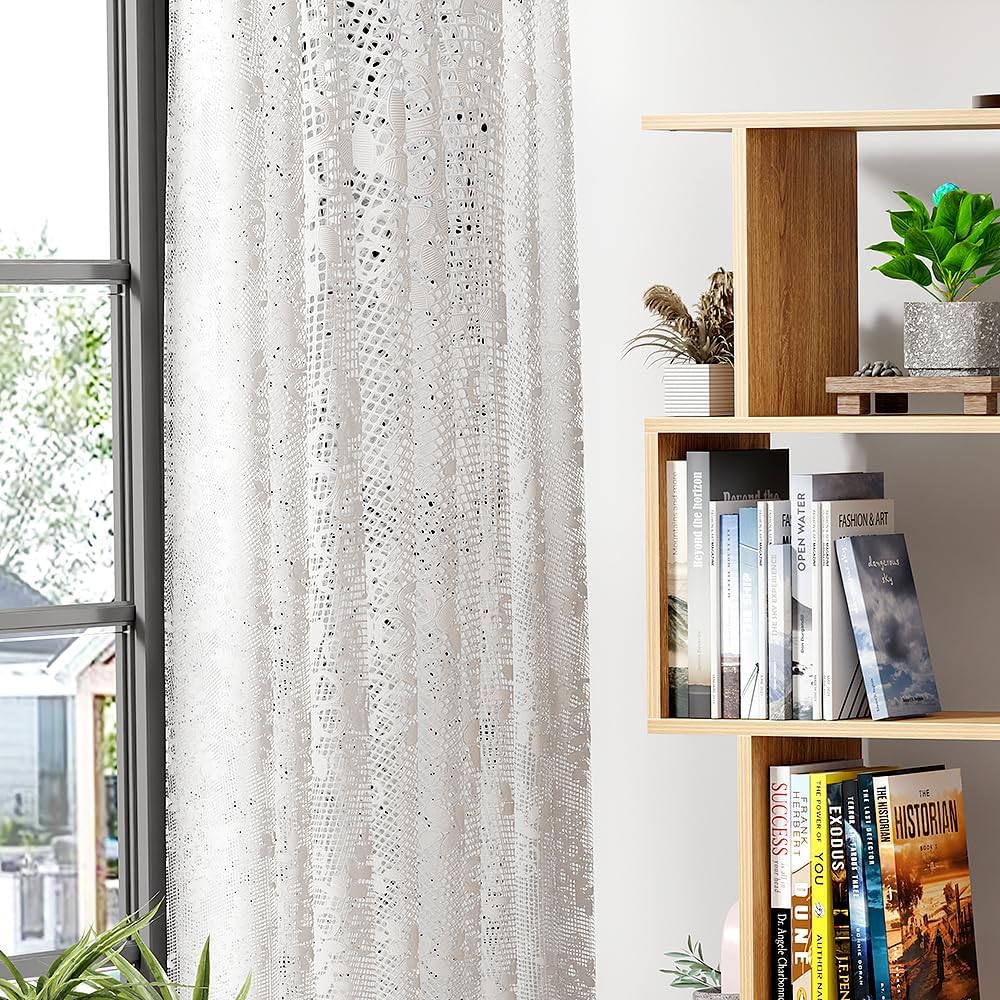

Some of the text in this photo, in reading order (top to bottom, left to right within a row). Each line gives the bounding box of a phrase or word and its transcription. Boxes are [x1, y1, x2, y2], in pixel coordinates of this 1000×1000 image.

[692, 472, 704, 568] Beyond the horizon
[797, 492, 806, 572] OPEN WATER
[838, 512, 868, 528] FASHION
[868, 512, 875, 527] &
[875, 511, 889, 526] ART
[867, 556, 900, 571] dangerous
[882, 573, 895, 586] sky
[847, 796, 856, 824] TERROR
[918, 789, 930, 798] THE
[772, 782, 788, 857] SUCCESS
[793, 791, 801, 857] HERBERT
[800, 796, 808, 845] FRANK
[862, 789, 875, 865] THE LAST DEFECTOR
[877, 786, 891, 843] THE HISTORIAN
[894, 800, 958, 839] HISTORIAN
[815, 832, 822, 843] OF
[829, 806, 845, 871] EXODUS
[814, 852, 825, 886] YOU
[777, 914, 788, 926] Dr.
[793, 882, 810, 966] DUNE
[774, 928, 788, 955] Angele
[836, 955, 848, 973] J.F.
